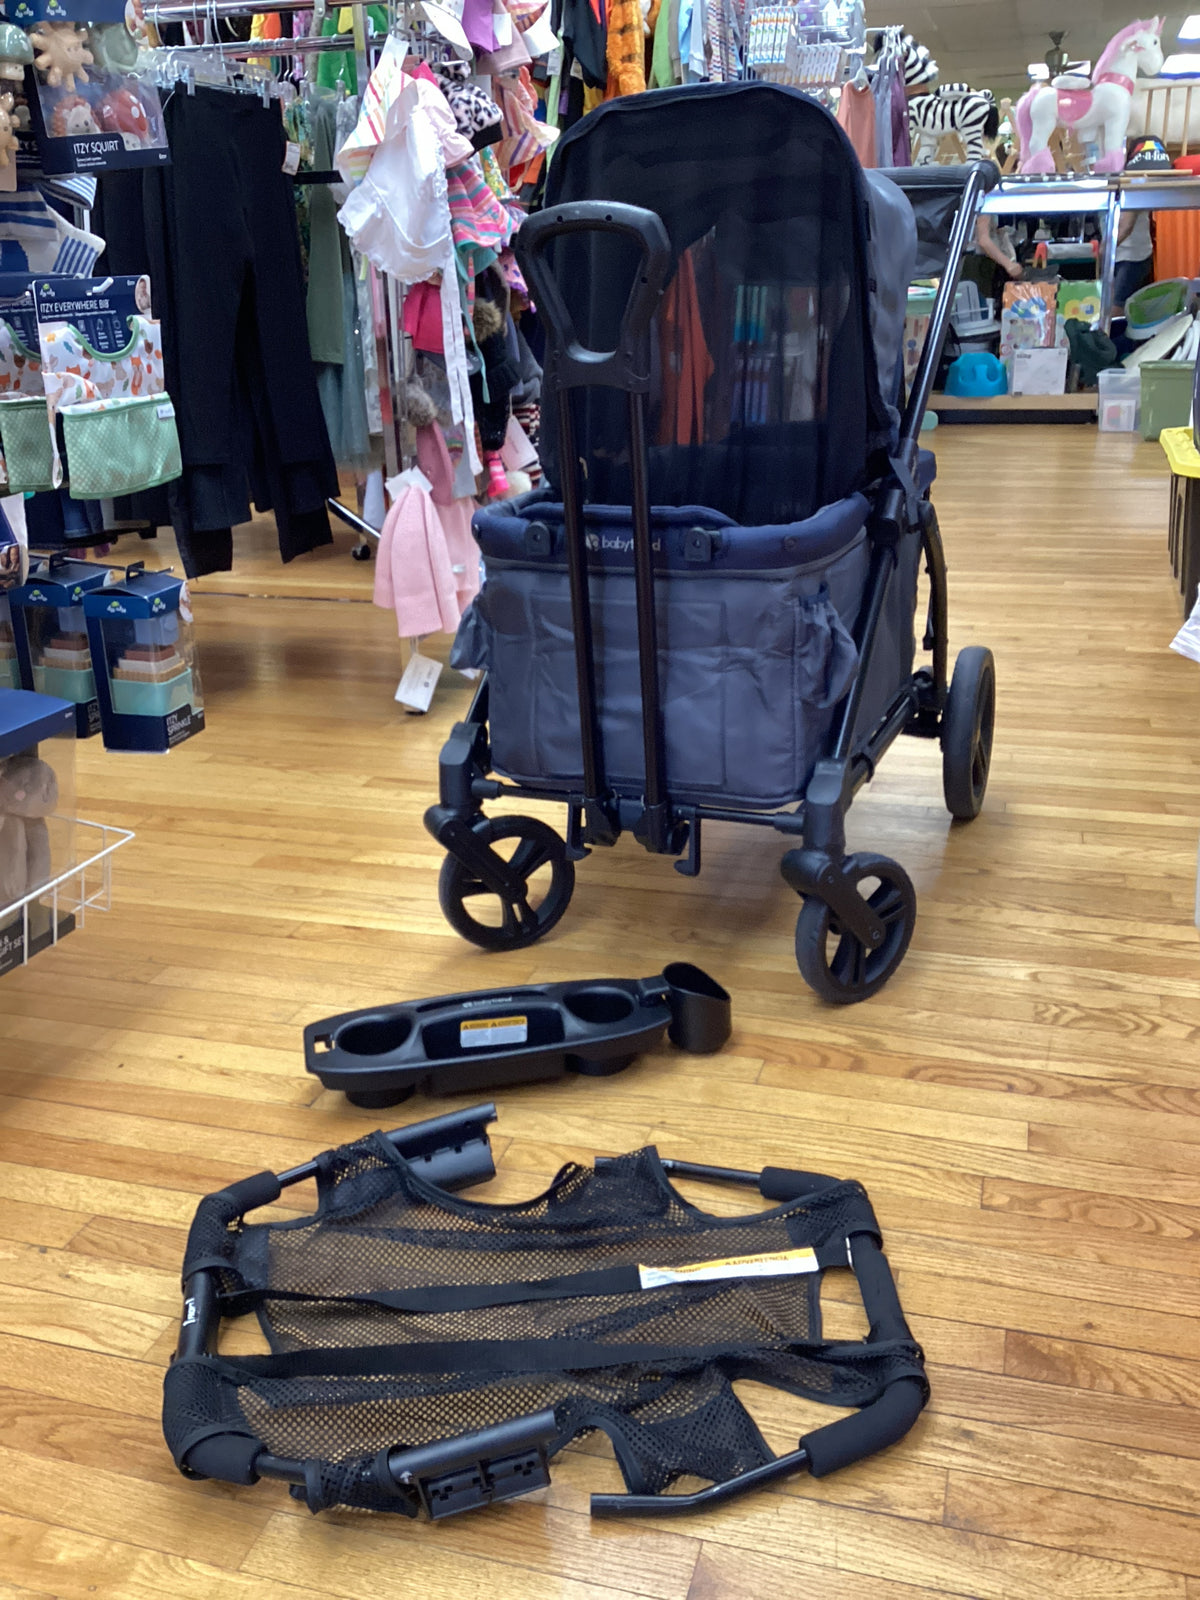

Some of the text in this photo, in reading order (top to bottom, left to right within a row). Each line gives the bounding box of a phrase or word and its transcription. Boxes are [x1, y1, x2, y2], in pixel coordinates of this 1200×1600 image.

[73, 140, 119, 154] ITZY SQUIRT
[40, 302, 54, 313] ITZY
[54, 300, 98, 312] EVERYWHERE
[602, 535, 661, 552] babytd
